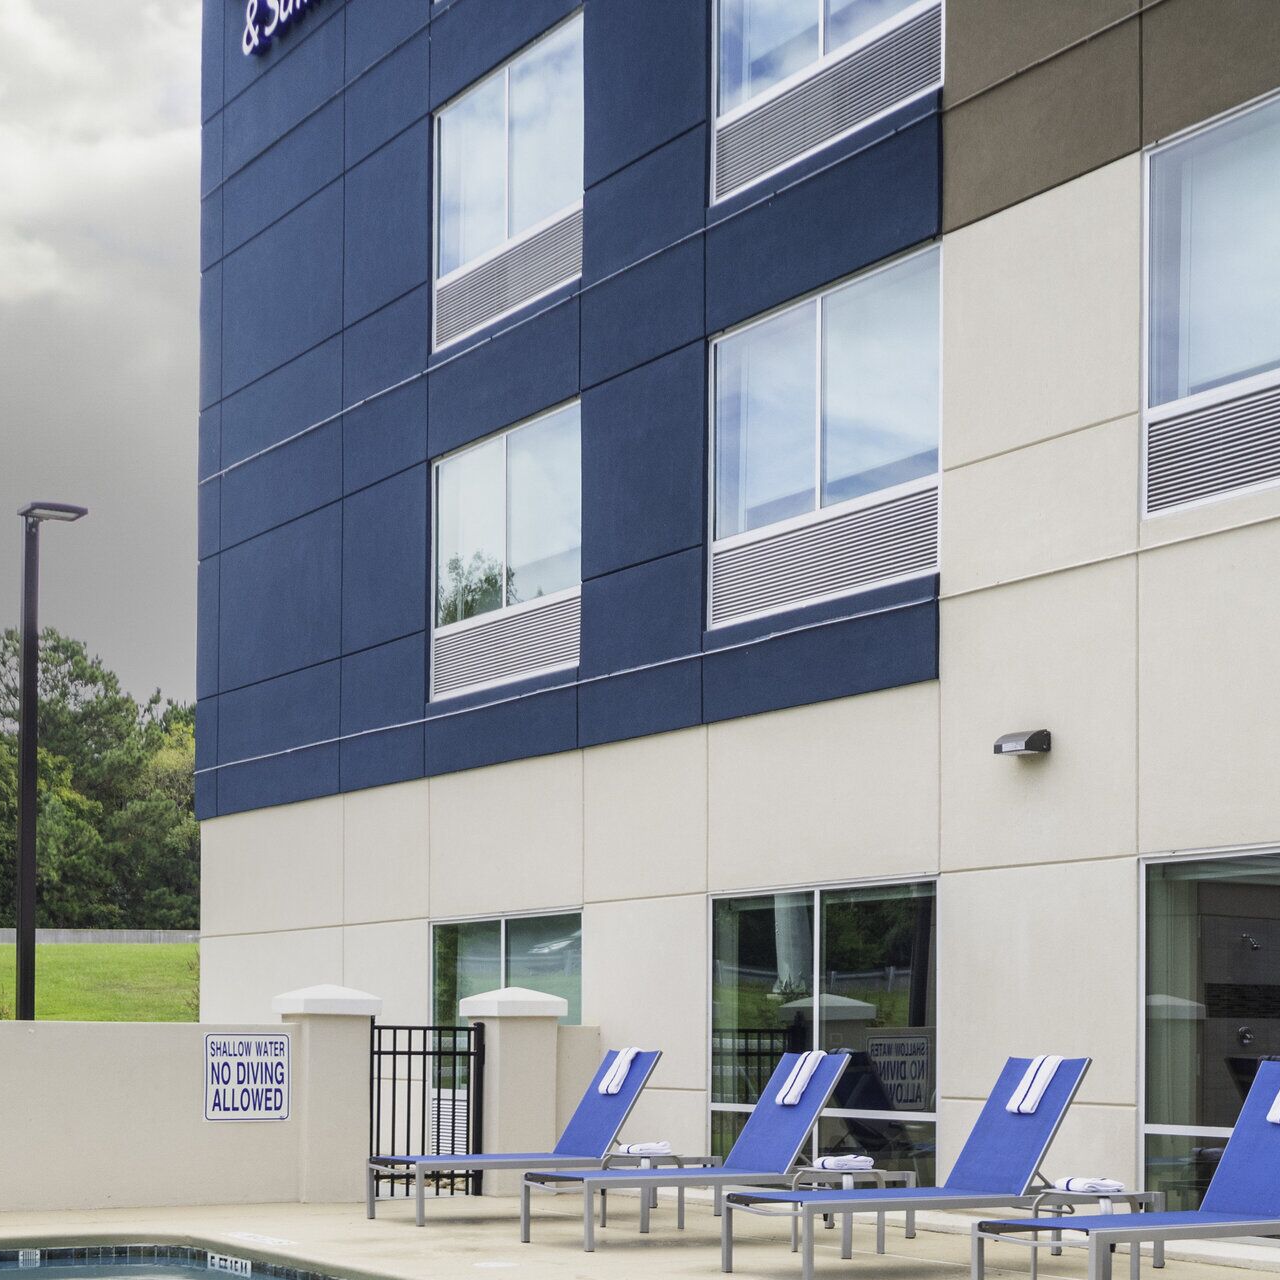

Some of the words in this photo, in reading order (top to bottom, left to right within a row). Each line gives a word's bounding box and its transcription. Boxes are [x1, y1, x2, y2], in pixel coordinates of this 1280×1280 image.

[210, 1041, 252, 1057] SHALLOW
[255, 1041, 285, 1057] WATER
[211, 1061, 231, 1085] NO
[237, 1061, 285, 1085] DIVING
[212, 1088, 283, 1111] ALLOWED
